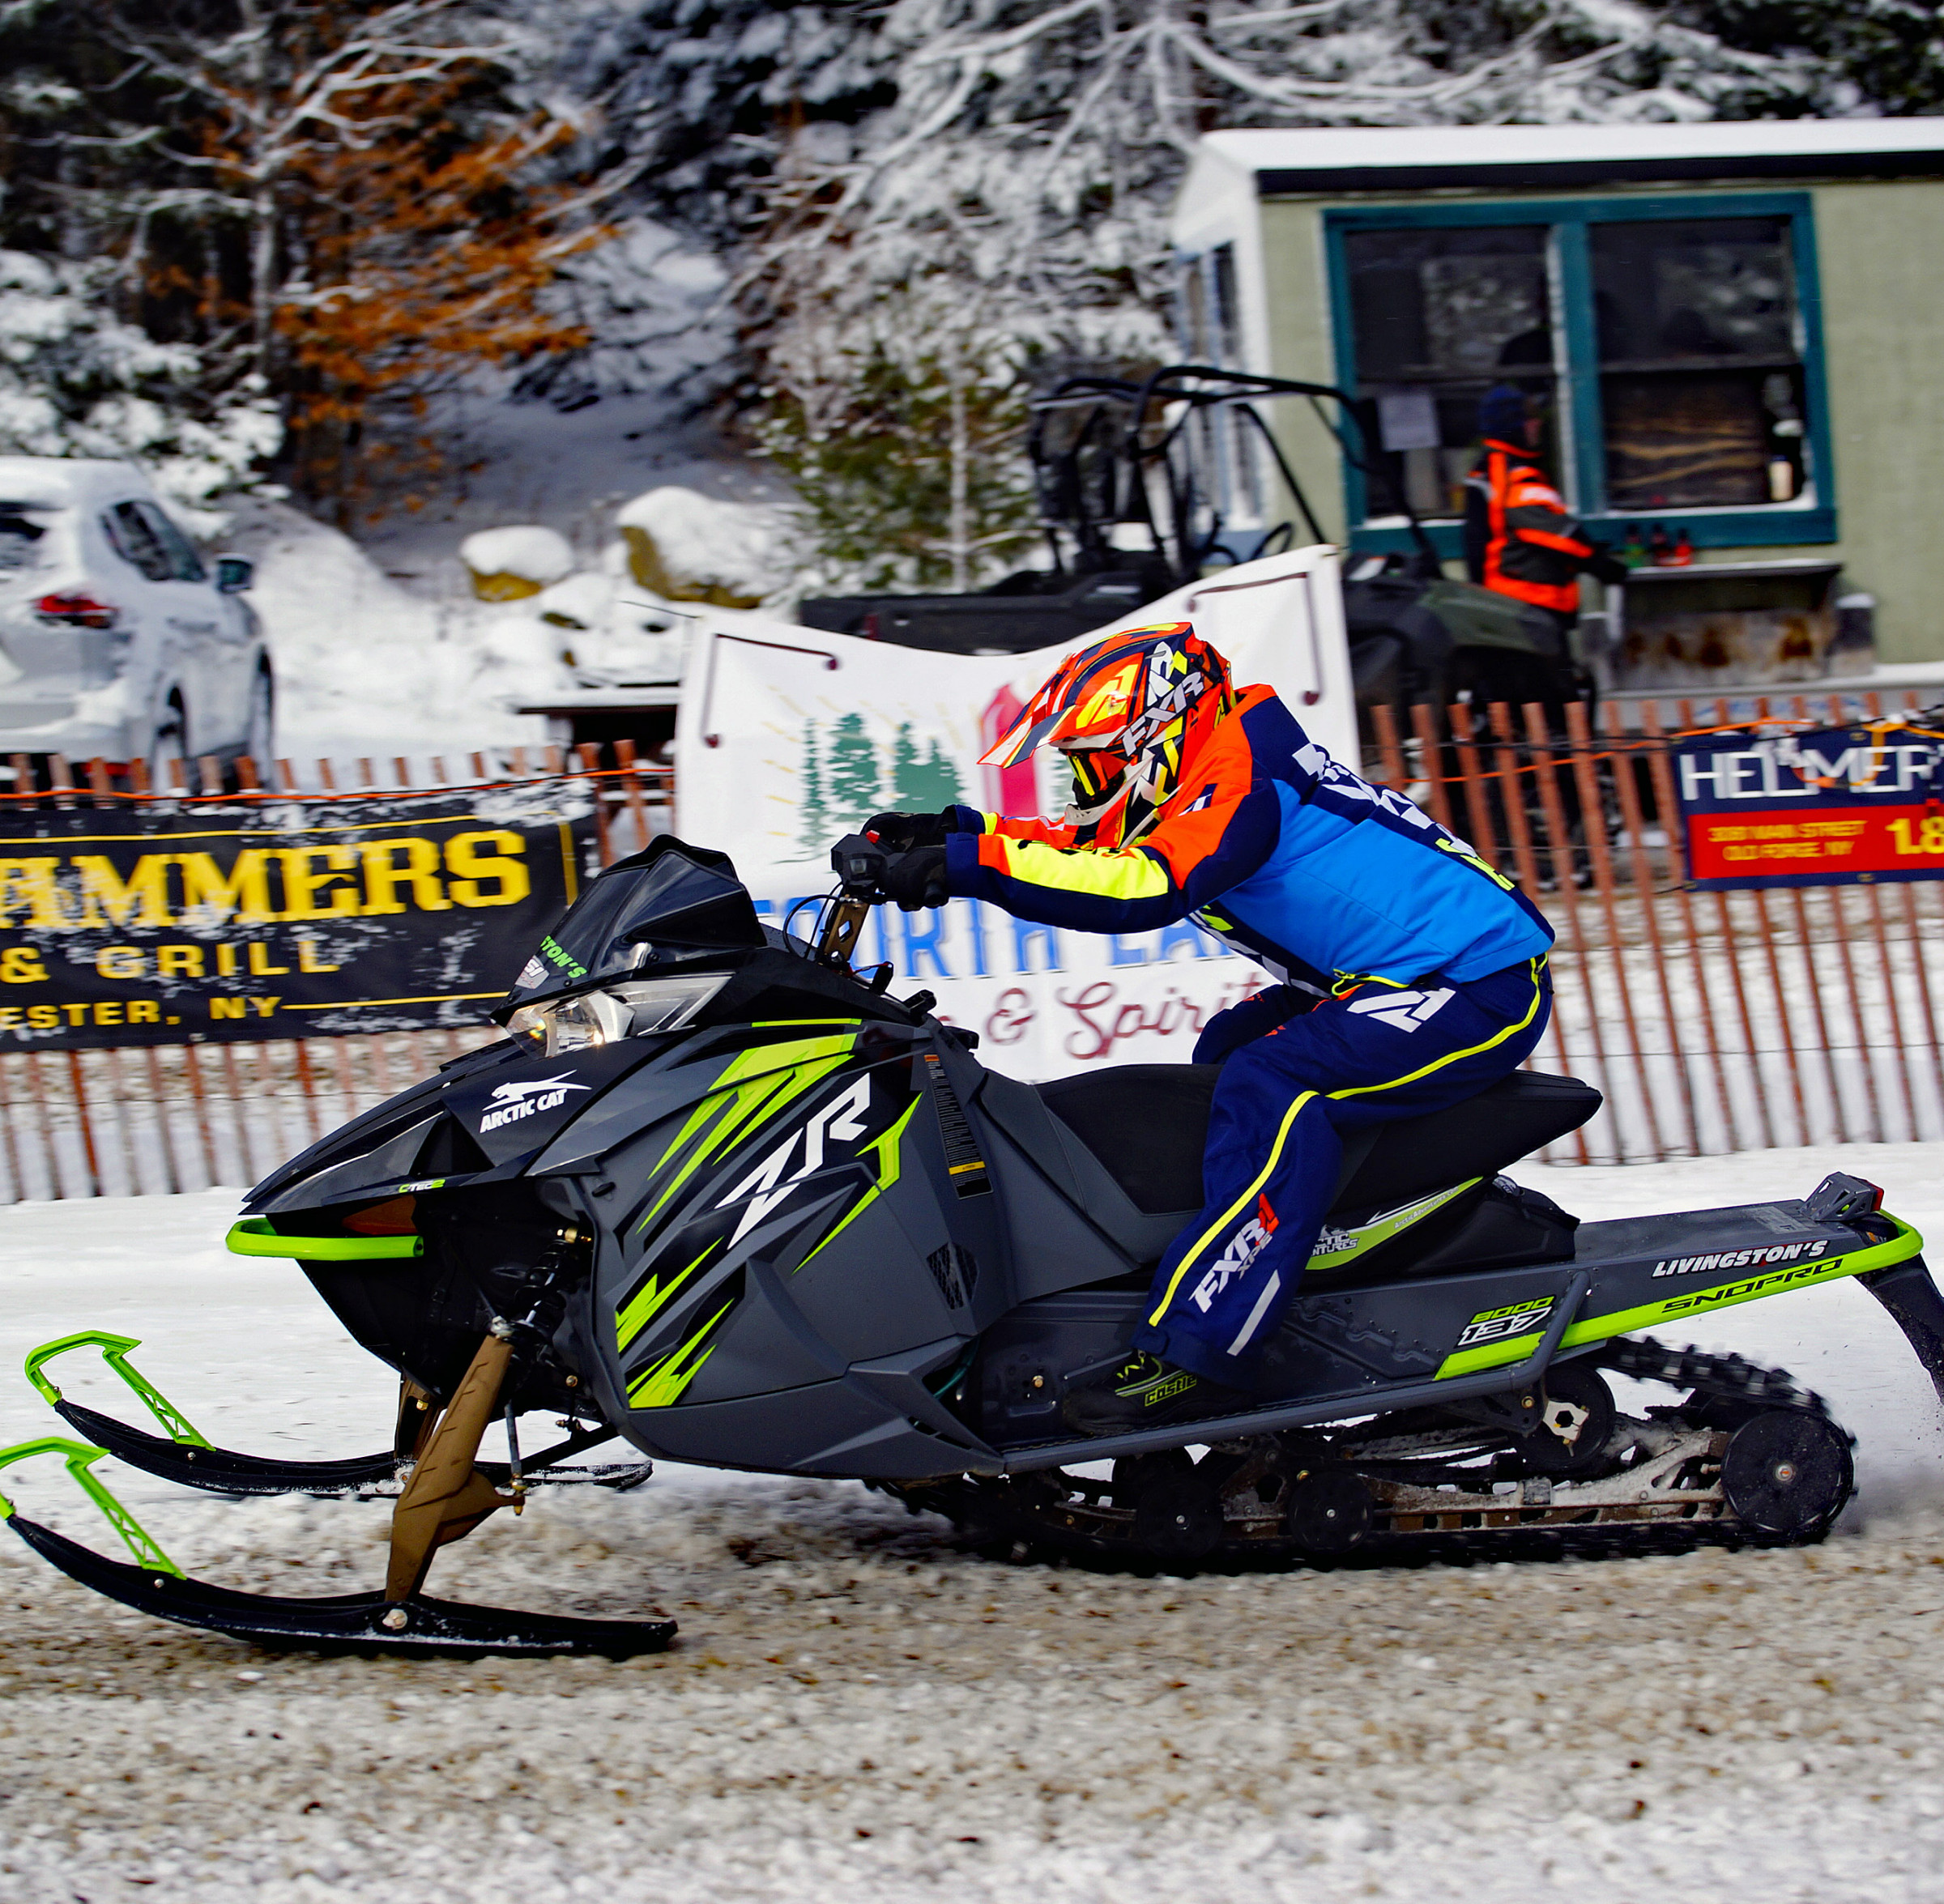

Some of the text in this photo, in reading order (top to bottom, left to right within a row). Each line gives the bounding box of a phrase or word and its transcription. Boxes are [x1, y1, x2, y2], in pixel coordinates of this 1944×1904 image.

[1115, 671, 1204, 757] FXR
[1679, 744, 1944, 800] HELMER
[1798, 820, 1868, 838] STREET
[0, 829, 531, 929] AMMERS
[0, 940, 340, 984] & GRILL
[209, 996, 283, 1020] NY
[479, 1088, 568, 1134] ARCTIC CAT
[714, 1071, 871, 1250] ZR
[1187, 1217, 1266, 1314] FXR
[1311, 1238, 1359, 1256] NTURES
[1652, 1240, 1829, 1278] LIVINGSTON'S
[1660, 1259, 1844, 1314] SNOPRO
